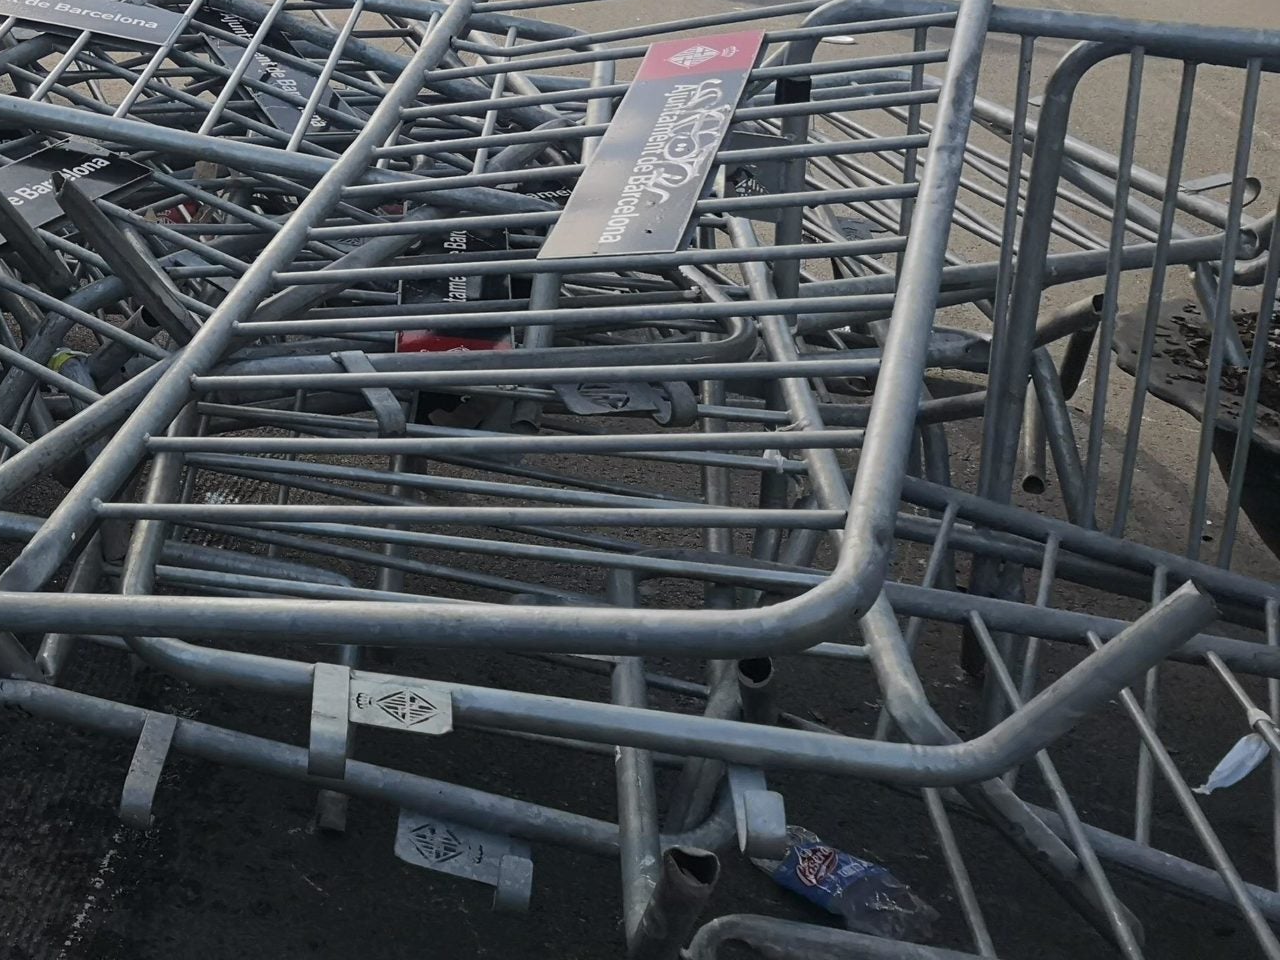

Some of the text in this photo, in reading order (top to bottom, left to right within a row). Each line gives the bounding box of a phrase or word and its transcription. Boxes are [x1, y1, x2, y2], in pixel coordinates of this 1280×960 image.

[53, 1, 160, 30] Barcelona
[641, 83, 699, 158] Ajuntament
[633, 156, 659, 174] de
[598, 173, 653, 244] Barcelona
